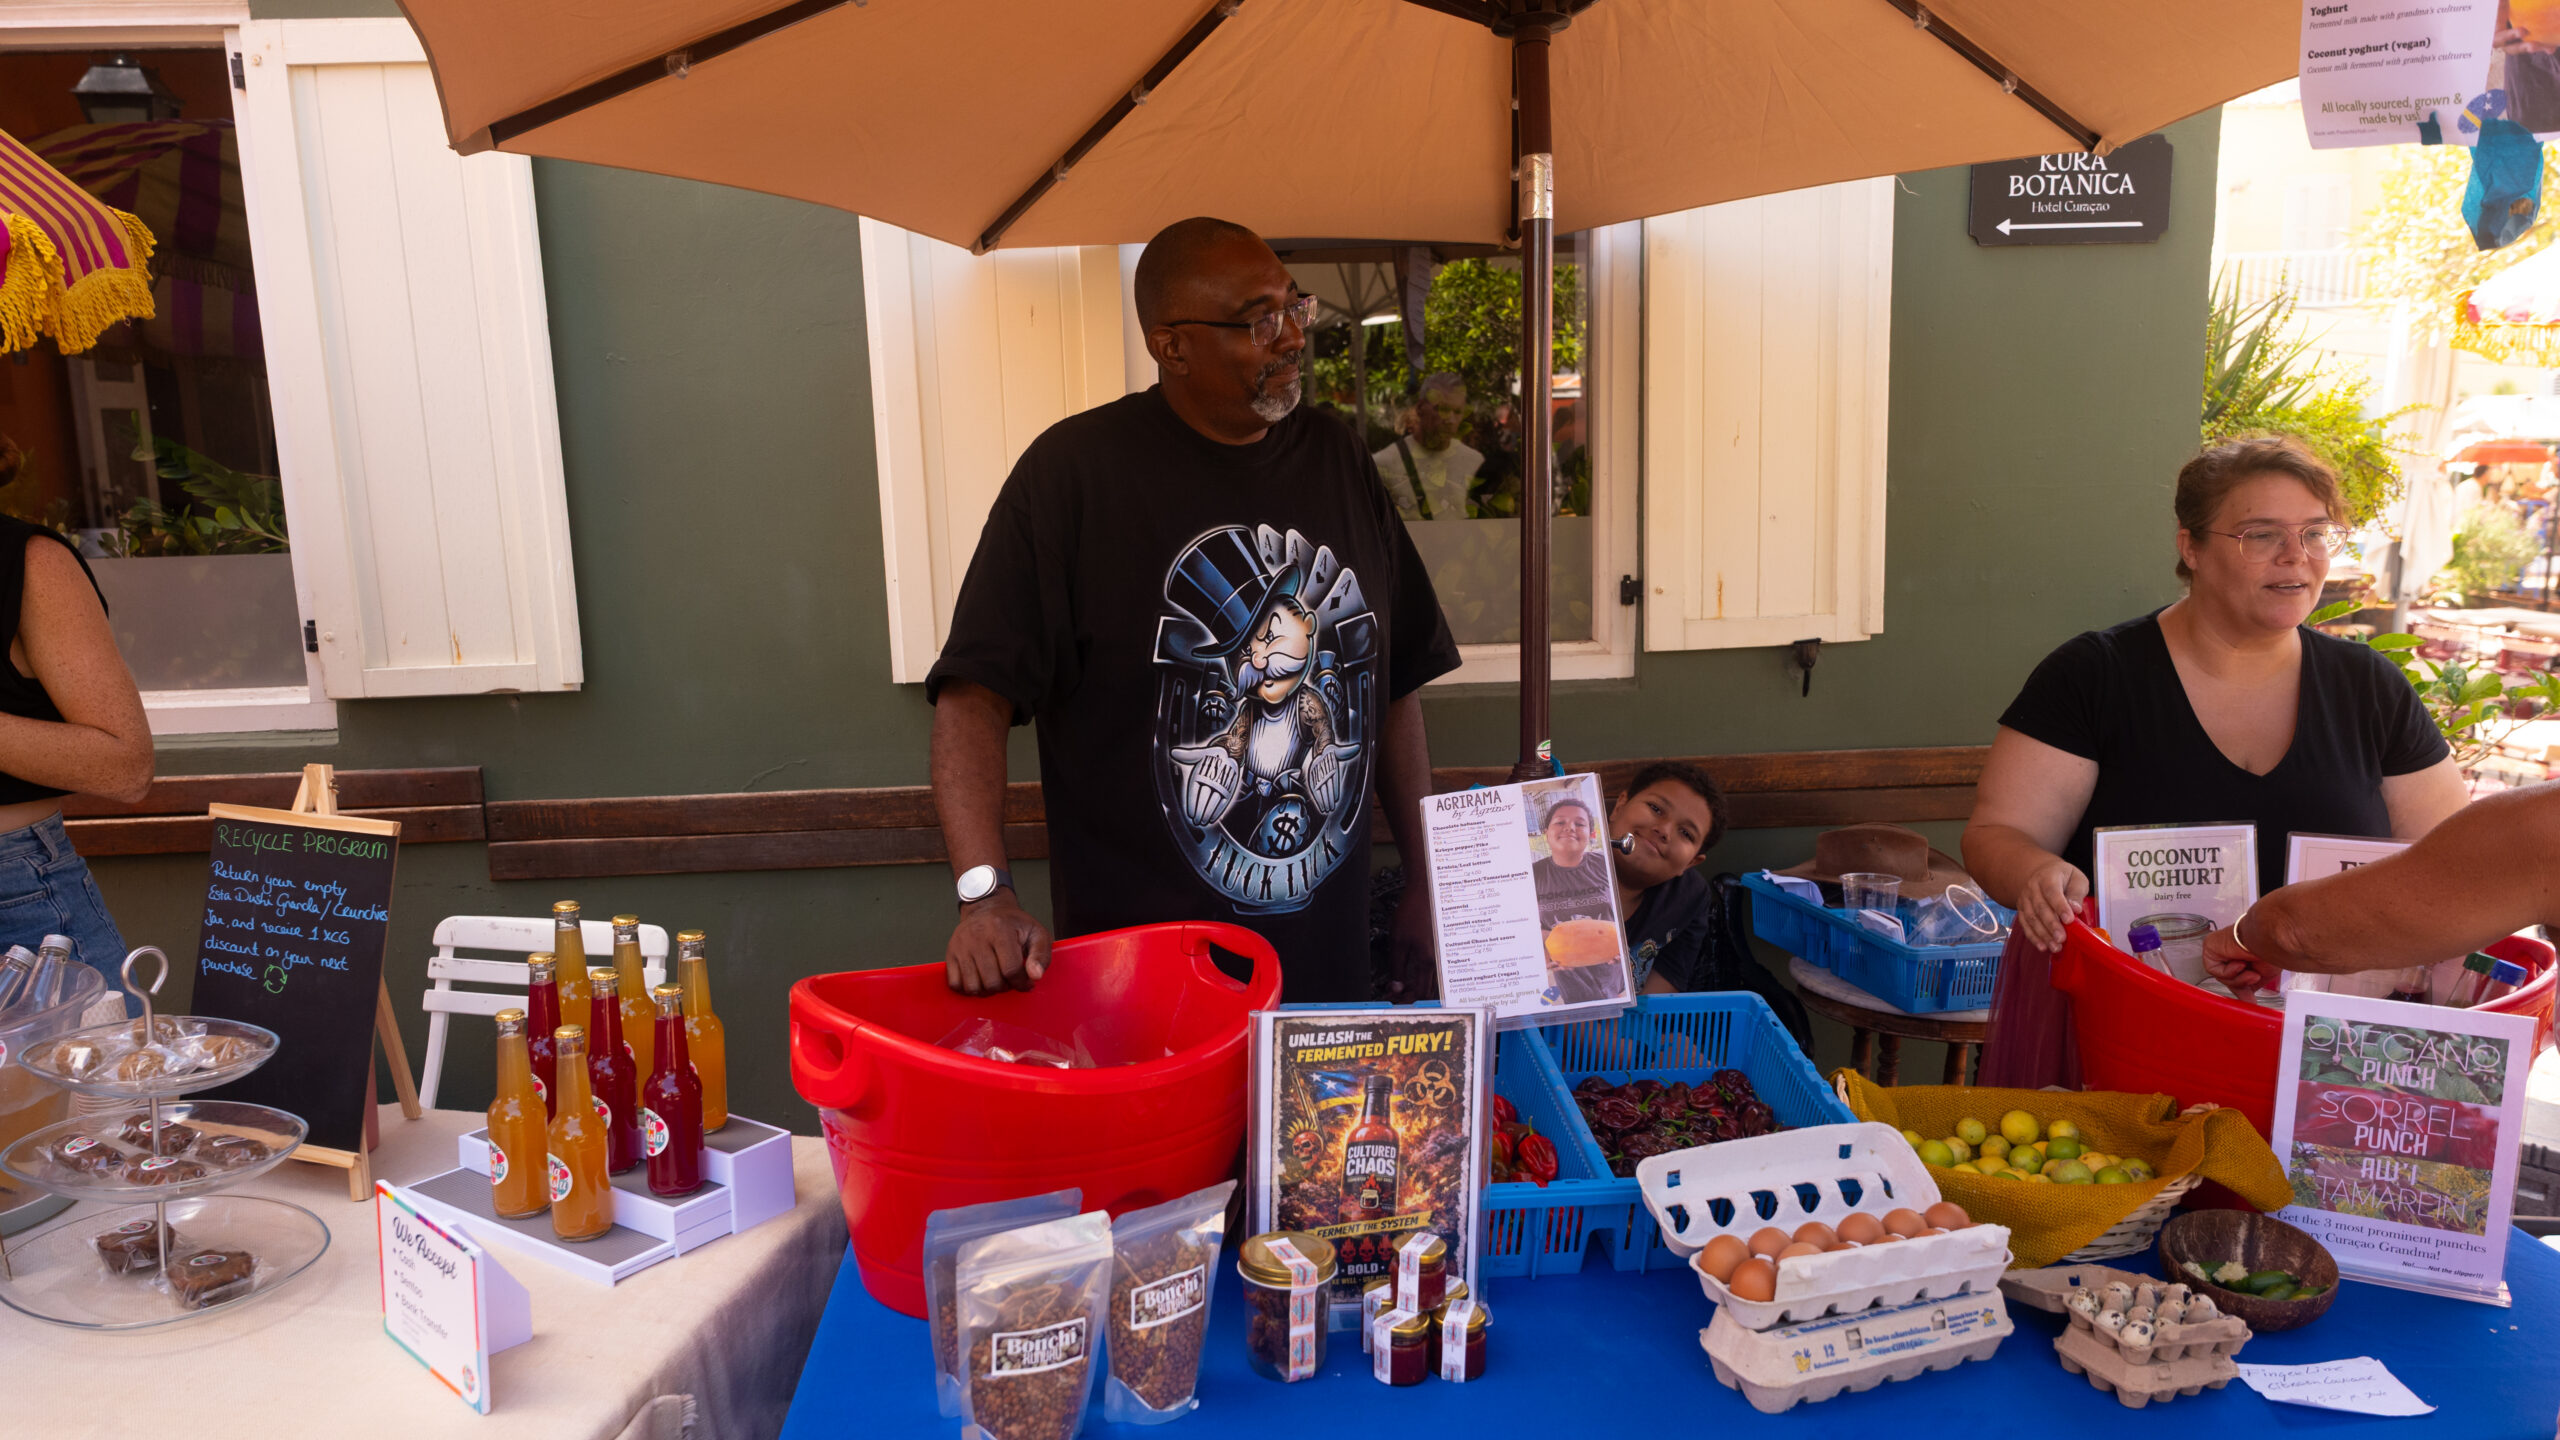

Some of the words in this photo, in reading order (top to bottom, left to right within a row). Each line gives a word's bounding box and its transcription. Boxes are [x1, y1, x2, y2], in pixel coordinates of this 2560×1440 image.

[2309, 19, 2342, 30] Fermented
[2344, 15, 2358, 25] milk
[2360, 14, 2378, 23] made
[2380, 12, 2395, 20] with
[2397, 7, 2434, 19] grandma's
[2437, 4, 2472, 14] cultures
[2311, 4, 2348, 16] Yoghurt
[2308, 48, 2346, 59] Coconut
[2349, 43, 2388, 56] yoghurt
[2391, 37, 2431, 52] (vegan)
[2307, 65, 2332, 74] Coconut
[2334, 63, 2348, 71] milk
[2350, 58, 2384, 69] fermented
[2386, 57, 2401, 66] with
[2403, 54, 2436, 66] grandpa's
[2438, 52, 2472, 61] cultures
[2321, 103, 2333, 113] All
[2336, 100, 2368, 114] locally
[2370, 96, 2412, 110] sourced,
[2415, 96, 2449, 110] grown
[2454, 93, 2462, 104] &
[2360, 113, 2386, 125] made
[2389, 112, 2402, 124] by
[2405, 111, 2420, 121] us!
[2040, 152, 2107, 171] KURA
[2009, 173, 2135, 196] BOTANICA
[2032, 201, 2061, 213] Hotel
[2065, 201, 2110, 214] Curaçao
[1265, 534, 1272, 551] A
[1291, 539, 1298, 558] A
[1320, 554, 1327, 572] A
[1341, 579, 1351, 596] A
[1437, 790, 1501, 812] AGRIRAMA
[1452, 810, 1465, 820] by
[218, 825, 293, 855] RECYCLE
[304, 832, 387, 859] PROGRAM
[1204, 835, 1277, 900] FUCK
[1286, 834, 1341, 898] LUCK
[2128, 847, 2221, 867] COCONUT
[212, 861, 259, 882] Return
[262, 876, 296, 894] your
[304, 881, 347, 904] empty
[2125, 868, 2225, 889] YOGHURT
[208, 885, 231, 900] Esta
[234, 887, 273, 906] Dushi
[2154, 893, 2174, 902] Dairy
[232, 918, 254, 929] and
[308, 927, 318, 940] 1
[205, 936, 259, 956] discount
[266, 947, 279, 957] on
[282, 951, 313, 969] your
[321, 957, 349, 970] next
[202, 958, 257, 980] purchase
[1289, 1031, 1355, 1047] UNLEASH
[1355, 1032, 1372, 1041] THE
[1297, 1043, 1384, 1063] FERMENTED
[1387, 1031, 1453, 1055] FURY!
[2307, 1022, 2501, 1073] OREGANO
[2361, 1060, 2437, 1090] PUNCH
[2320, 1089, 2472, 1141] SORREL
[1348, 1145, 1396, 1158] CULTURED
[2354, 1125, 2428, 1156] PUNCH
[1346, 1157, 1395, 1176] CHAOS
[2316, 1174, 2466, 1222] TAMAREIN
[1317, 1222, 1361, 1238] FERMENT
[1363, 1222, 1377, 1230] THE
[1380, 1216, 1419, 1229] SYSTEM
[2277, 1210, 2298, 1222] Get
[2302, 1214, 2320, 1227] the
[2323, 1217, 2332, 1228] 3
[2335, 1222, 2364, 1234] most
[2368, 1226, 2432, 1245] prominent
[2435, 1237, 2487, 1254] punches
[393, 1217, 414, 1247] We
[416, 1234, 457, 1279] Accept
[2325, 1231, 2375, 1250] Curaçao
[2378, 1242, 2441, 1261] Grandma!
[1347, 1263, 1378, 1275] BOLD
[2442, 1267, 2453, 1275] the
[1145, 1274, 1198, 1309] Bonchi
[1007, 1327, 1077, 1355] Bonchi
[1824, 1344, 1835, 1358] 12
